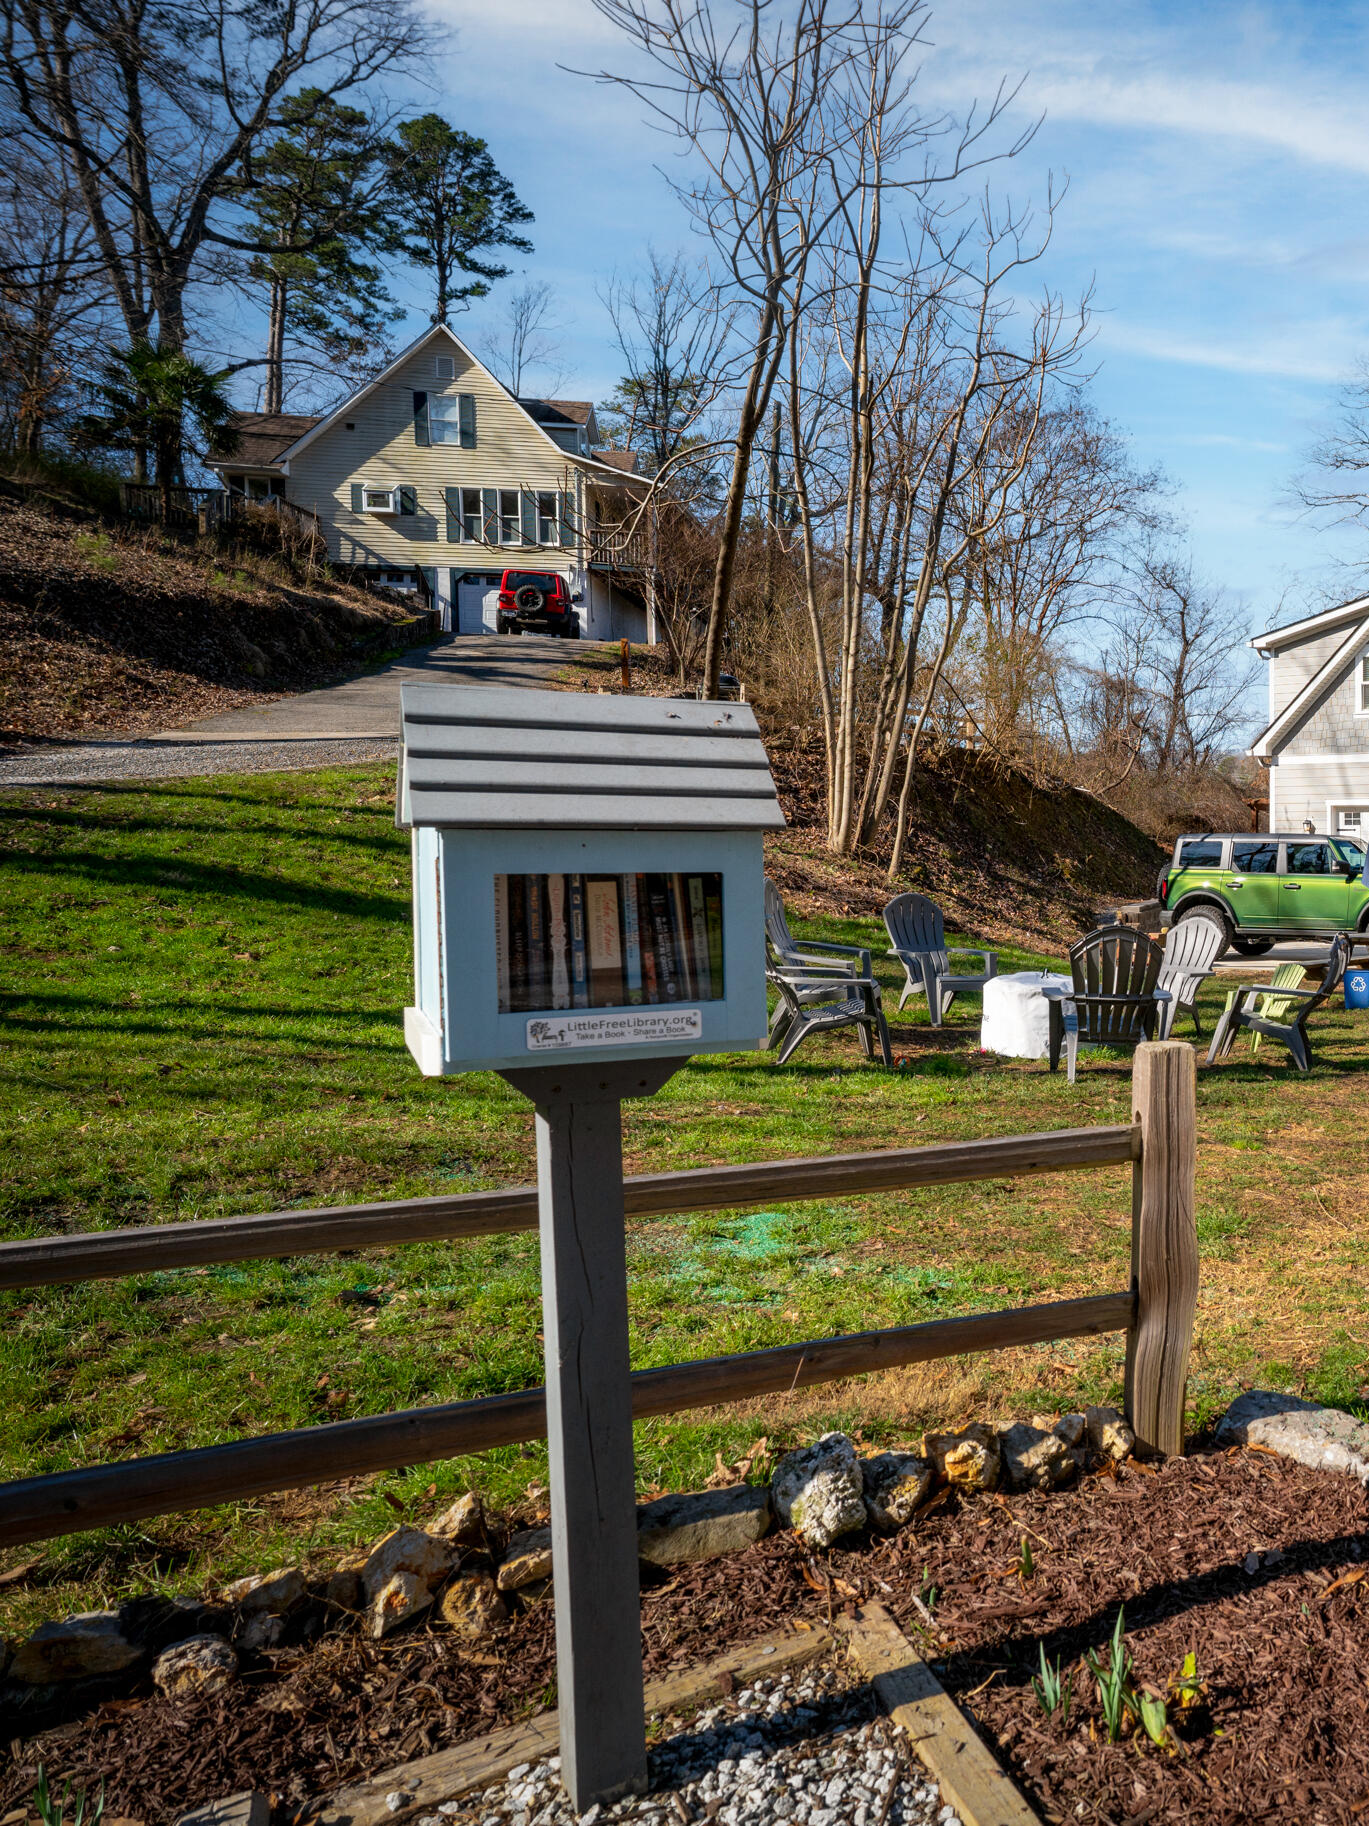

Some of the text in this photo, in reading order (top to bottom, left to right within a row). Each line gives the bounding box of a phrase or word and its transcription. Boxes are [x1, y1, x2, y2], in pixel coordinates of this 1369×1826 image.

[567, 1016, 693, 1032] LittleFreeLibrary.org
[605, 1030, 625, 1039] Book
[633, 1028, 656, 1036] Share
[666, 1026, 686, 1034] Book
